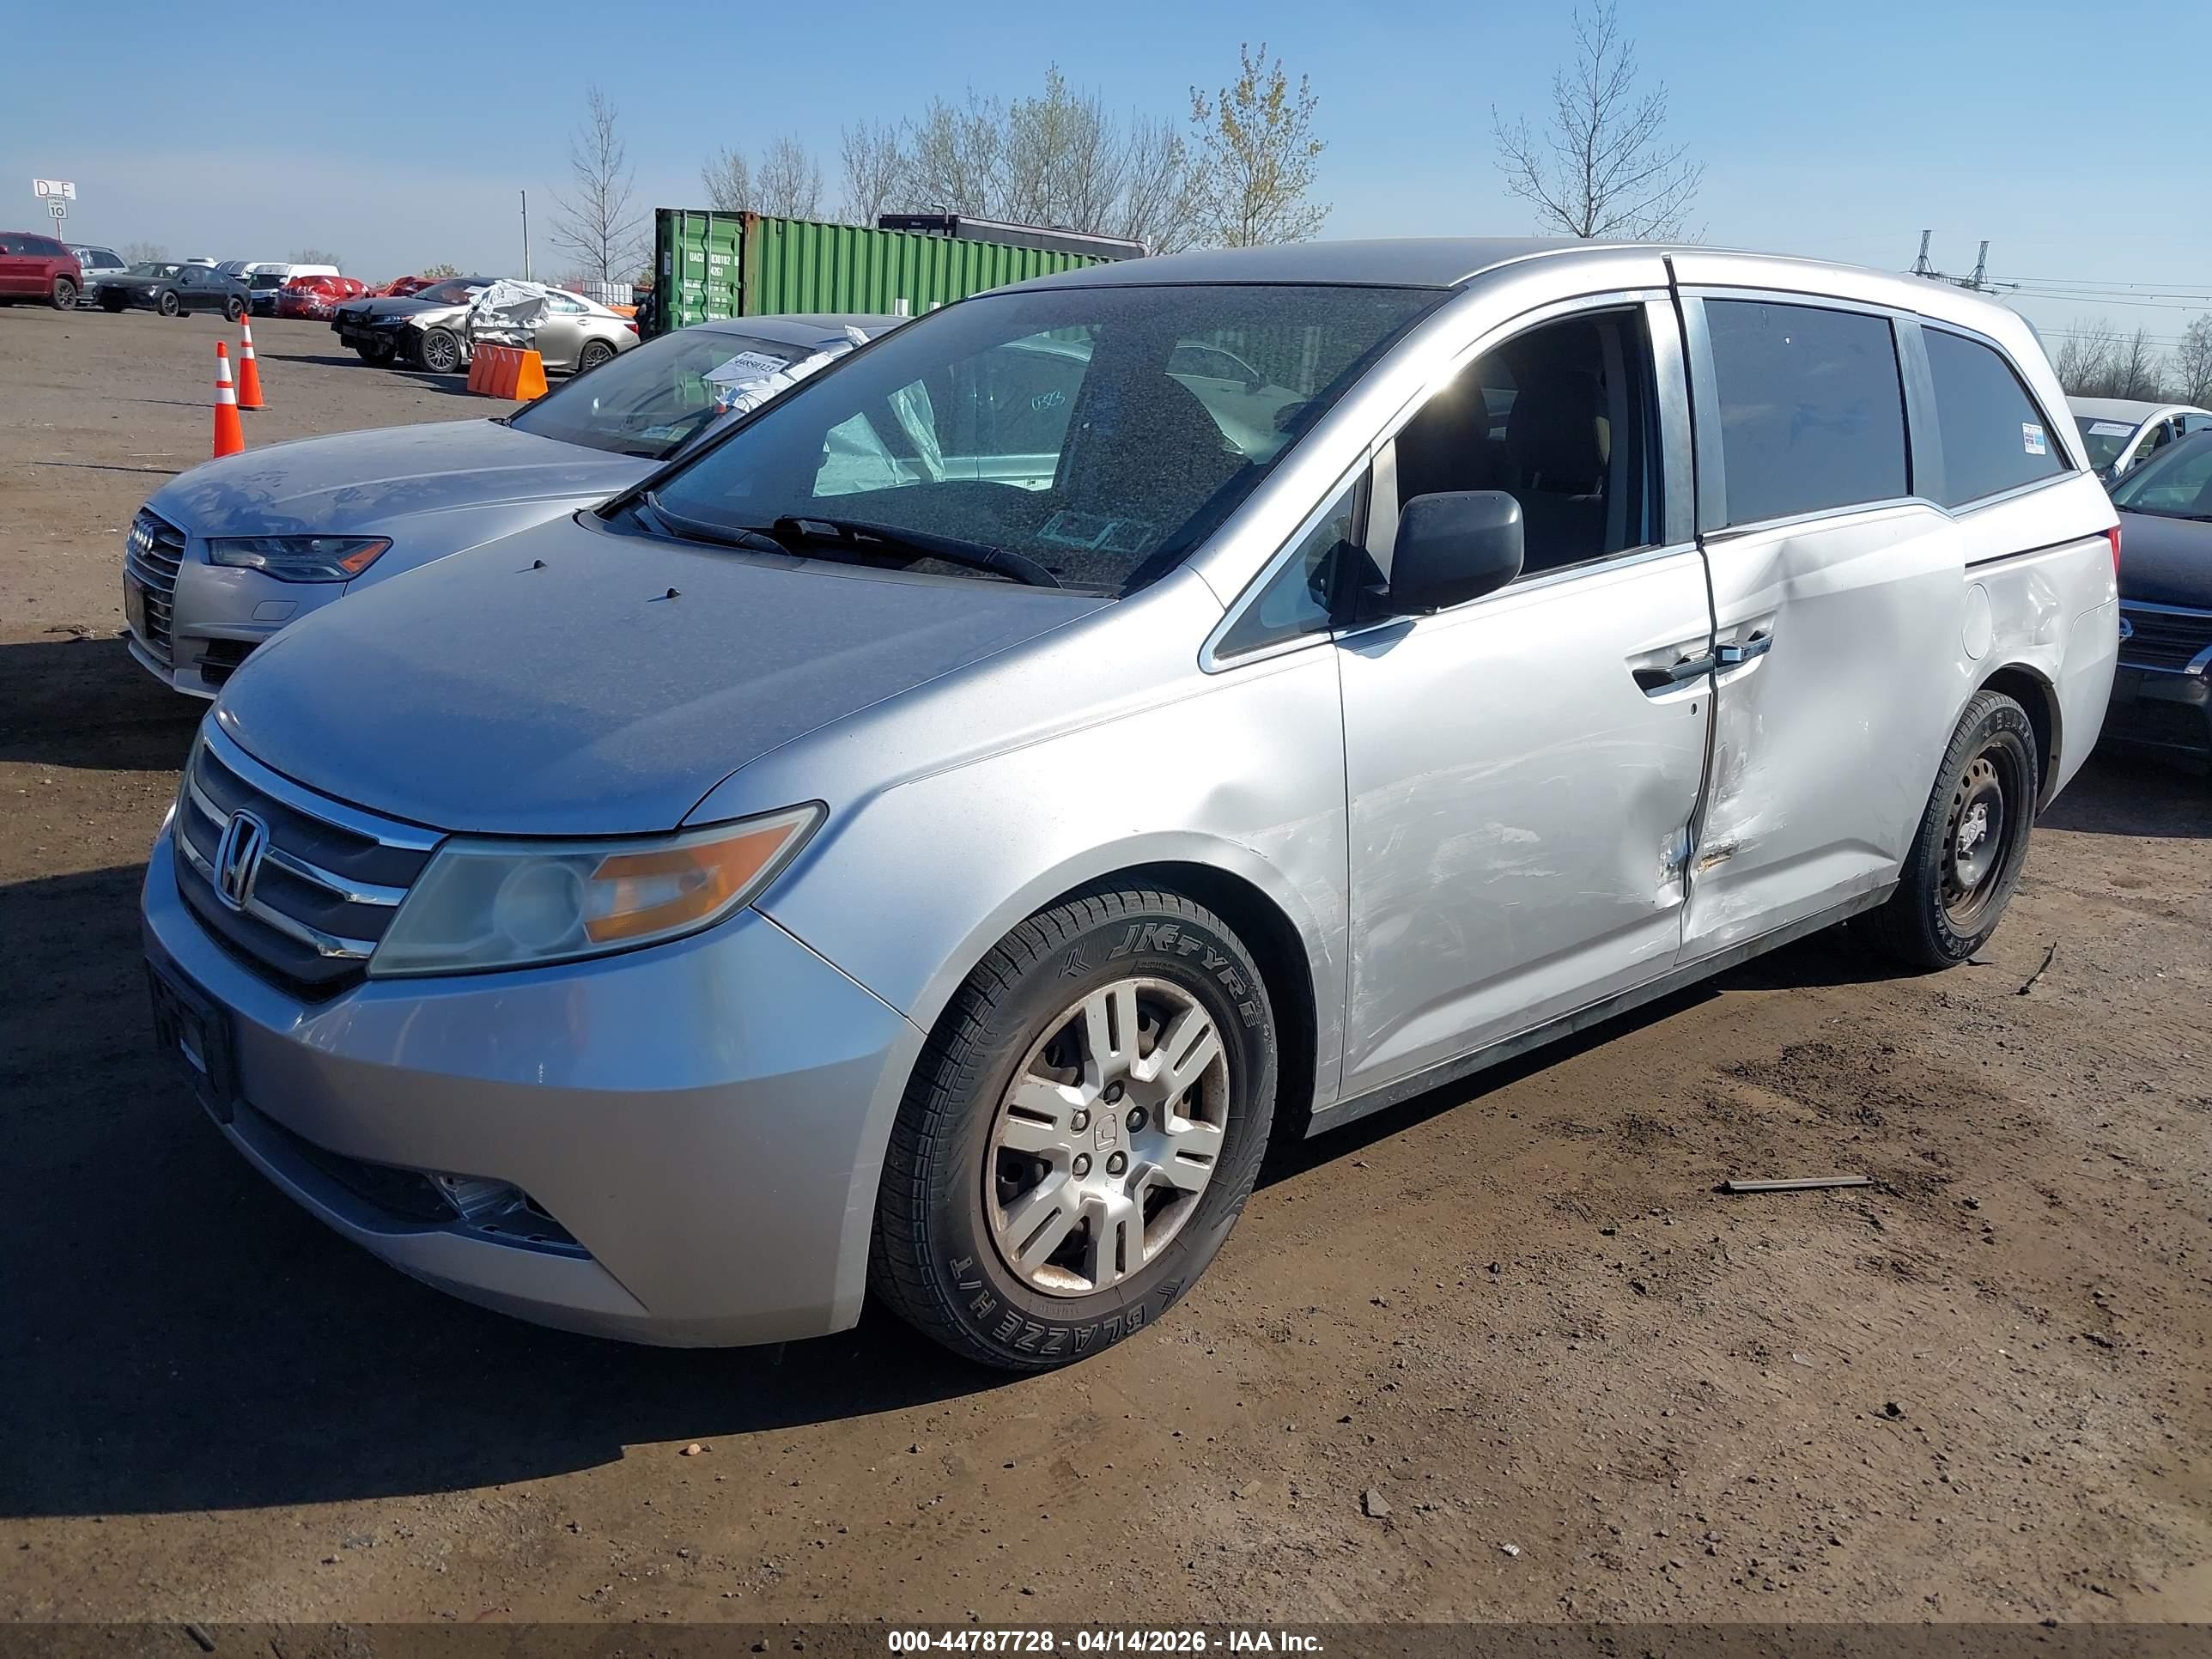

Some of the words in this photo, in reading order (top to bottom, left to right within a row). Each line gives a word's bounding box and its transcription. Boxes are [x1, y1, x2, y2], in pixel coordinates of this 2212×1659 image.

[37, 180, 50, 196] D
[51, 207, 64, 216] 10
[992, 1304, 1146, 1356] BLAZZE
